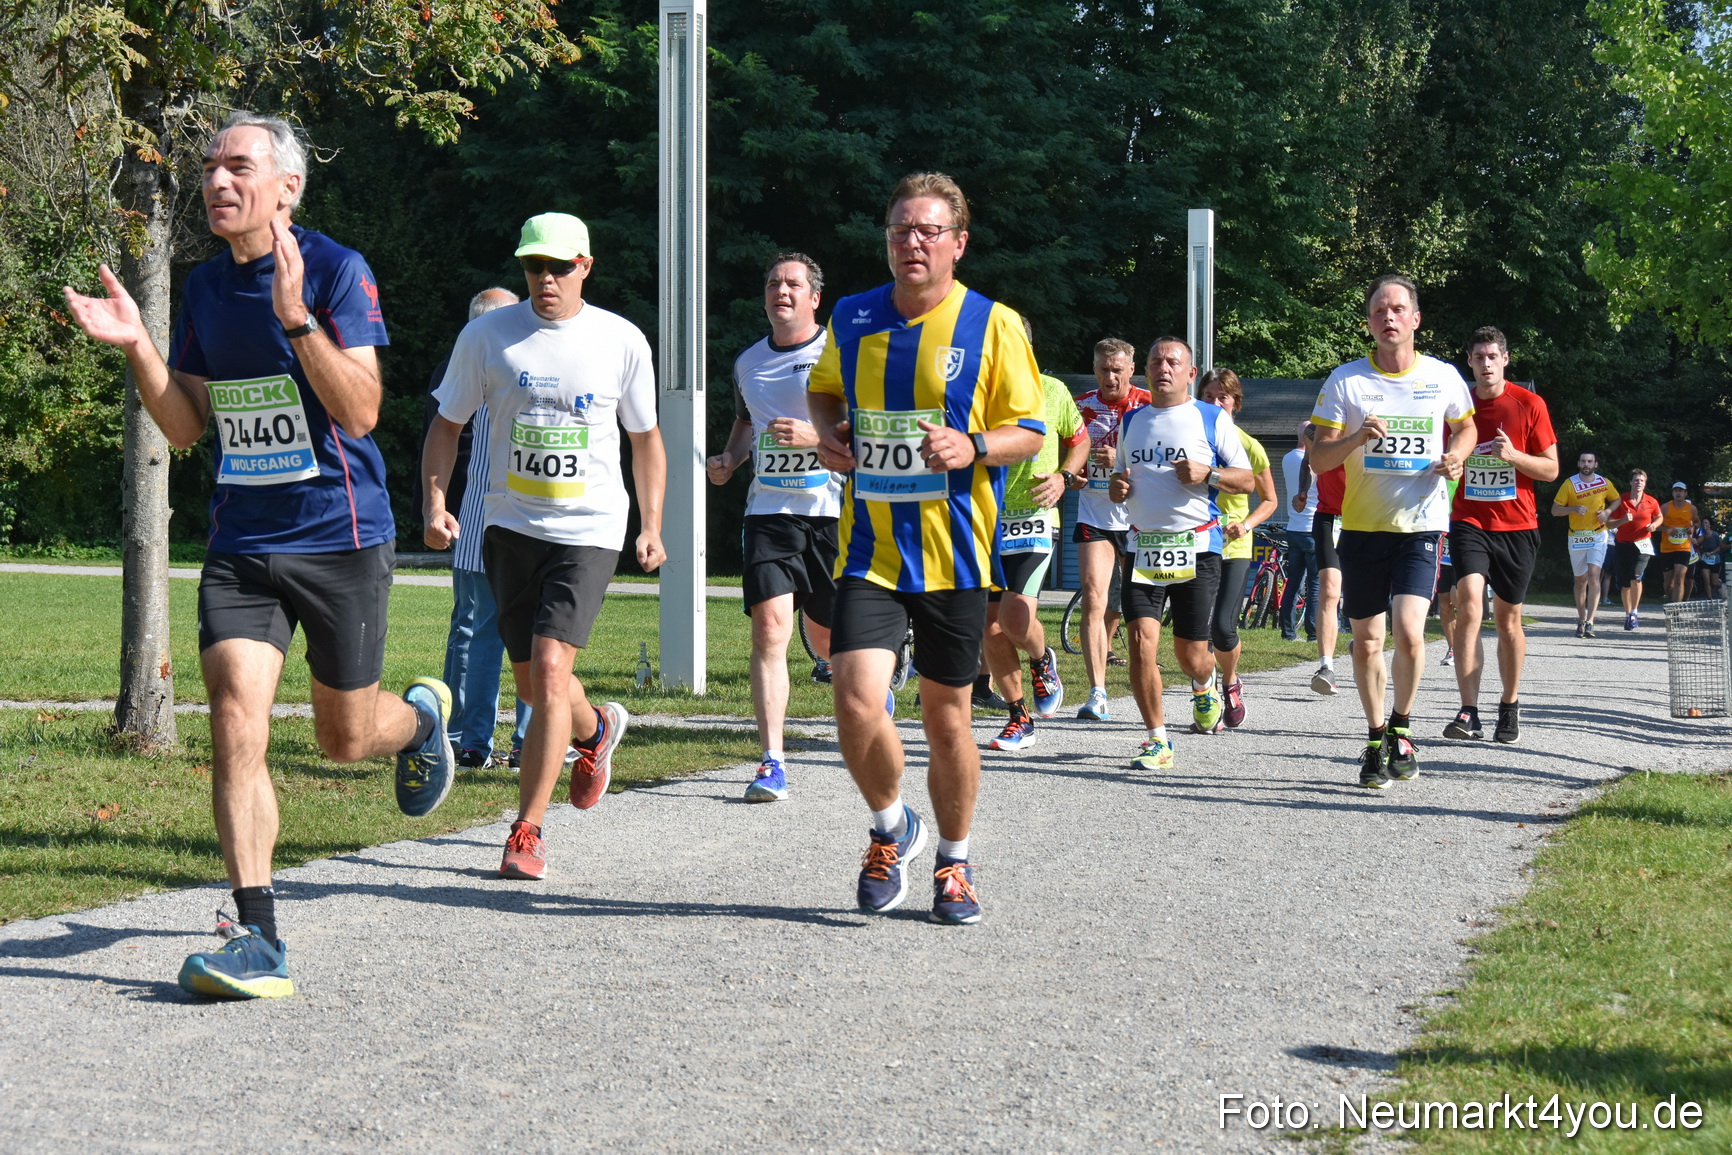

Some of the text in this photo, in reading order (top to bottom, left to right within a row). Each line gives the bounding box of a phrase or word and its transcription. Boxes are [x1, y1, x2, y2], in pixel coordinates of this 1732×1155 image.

[212, 379, 292, 408] BOCK
[224, 414, 295, 448] 2440
[858, 413, 933, 435] BOCK
[1378, 416, 1428, 432] OCK
[512, 424, 582, 447] BOCK
[1372, 437, 1425, 454] 2323
[230, 454, 302, 471] WOLFGANG
[764, 452, 820, 473] 2222
[1131, 441, 1188, 468] SUSPA
[513, 450, 578, 477] 1403
[781, 479, 806, 487] UWE
[869, 478, 917, 493] Wolfgang
[1470, 470, 1509, 485] 2175
[1473, 488, 1507, 496] THOMAS
[1000, 519, 1045, 537] 2693
[1140, 533, 1187, 546] BOCK
[1144, 551, 1188, 567] 1293
[1153, 572, 1175, 580] AKIN
